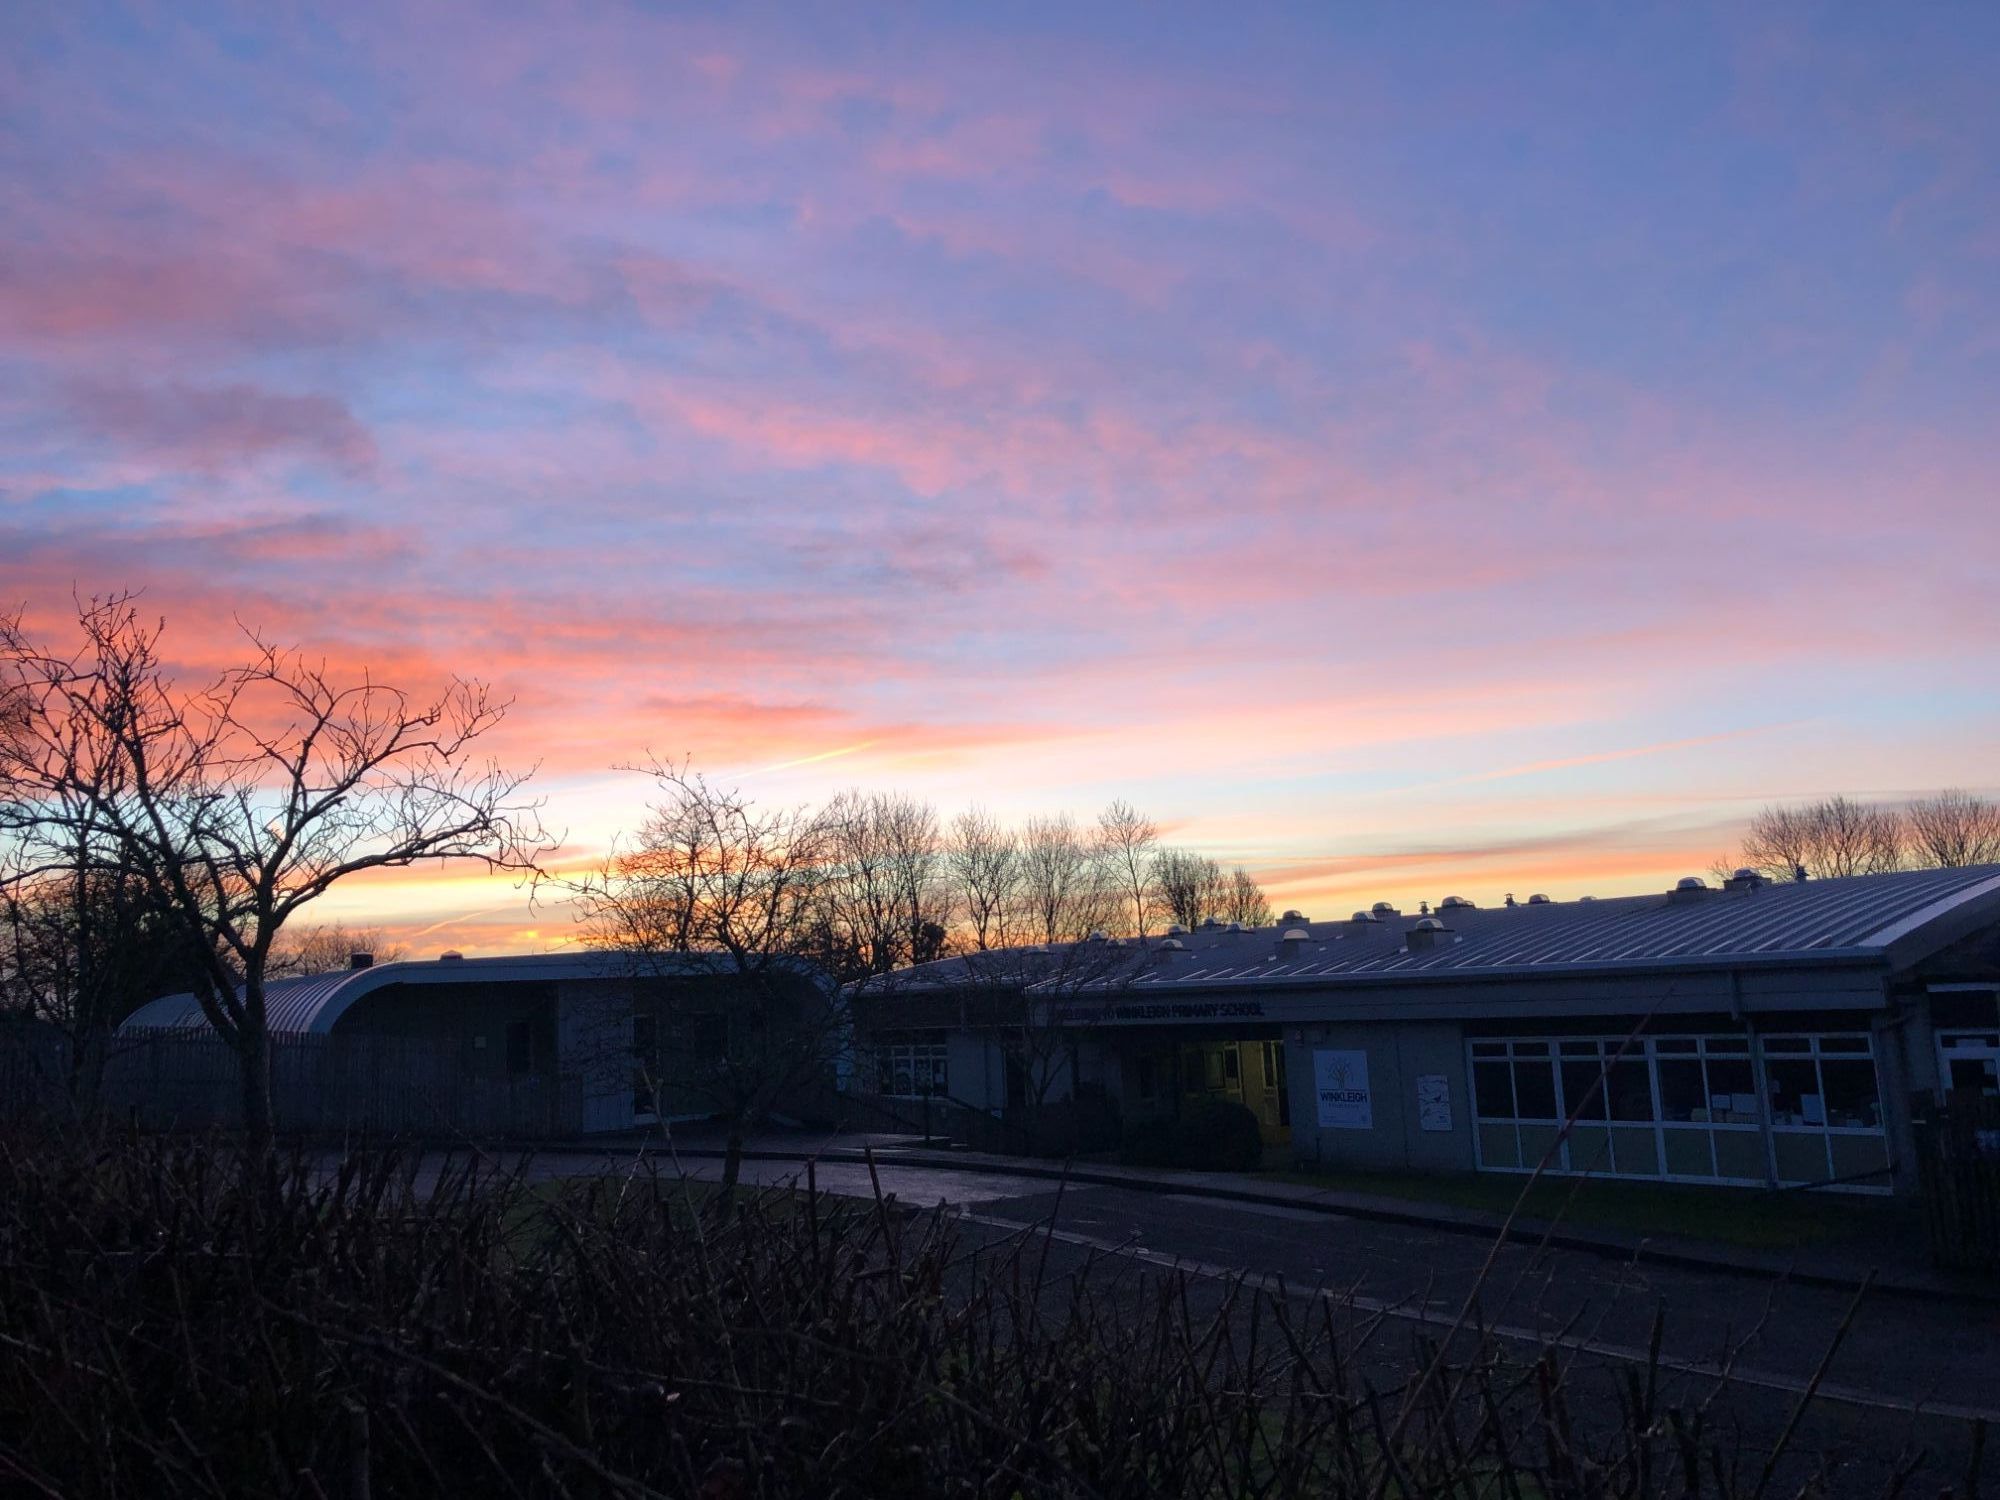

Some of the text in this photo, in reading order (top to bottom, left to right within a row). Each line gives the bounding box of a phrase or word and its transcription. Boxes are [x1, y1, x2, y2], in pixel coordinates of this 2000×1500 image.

[1115, 1005, 1171, 1019] WINKLEIGH
[1172, 1003, 1217, 1017] PRIMARY
[1219, 1002, 1265, 1016] SCHOOL
[1319, 1091, 1368, 1103] WINKLEIGH
